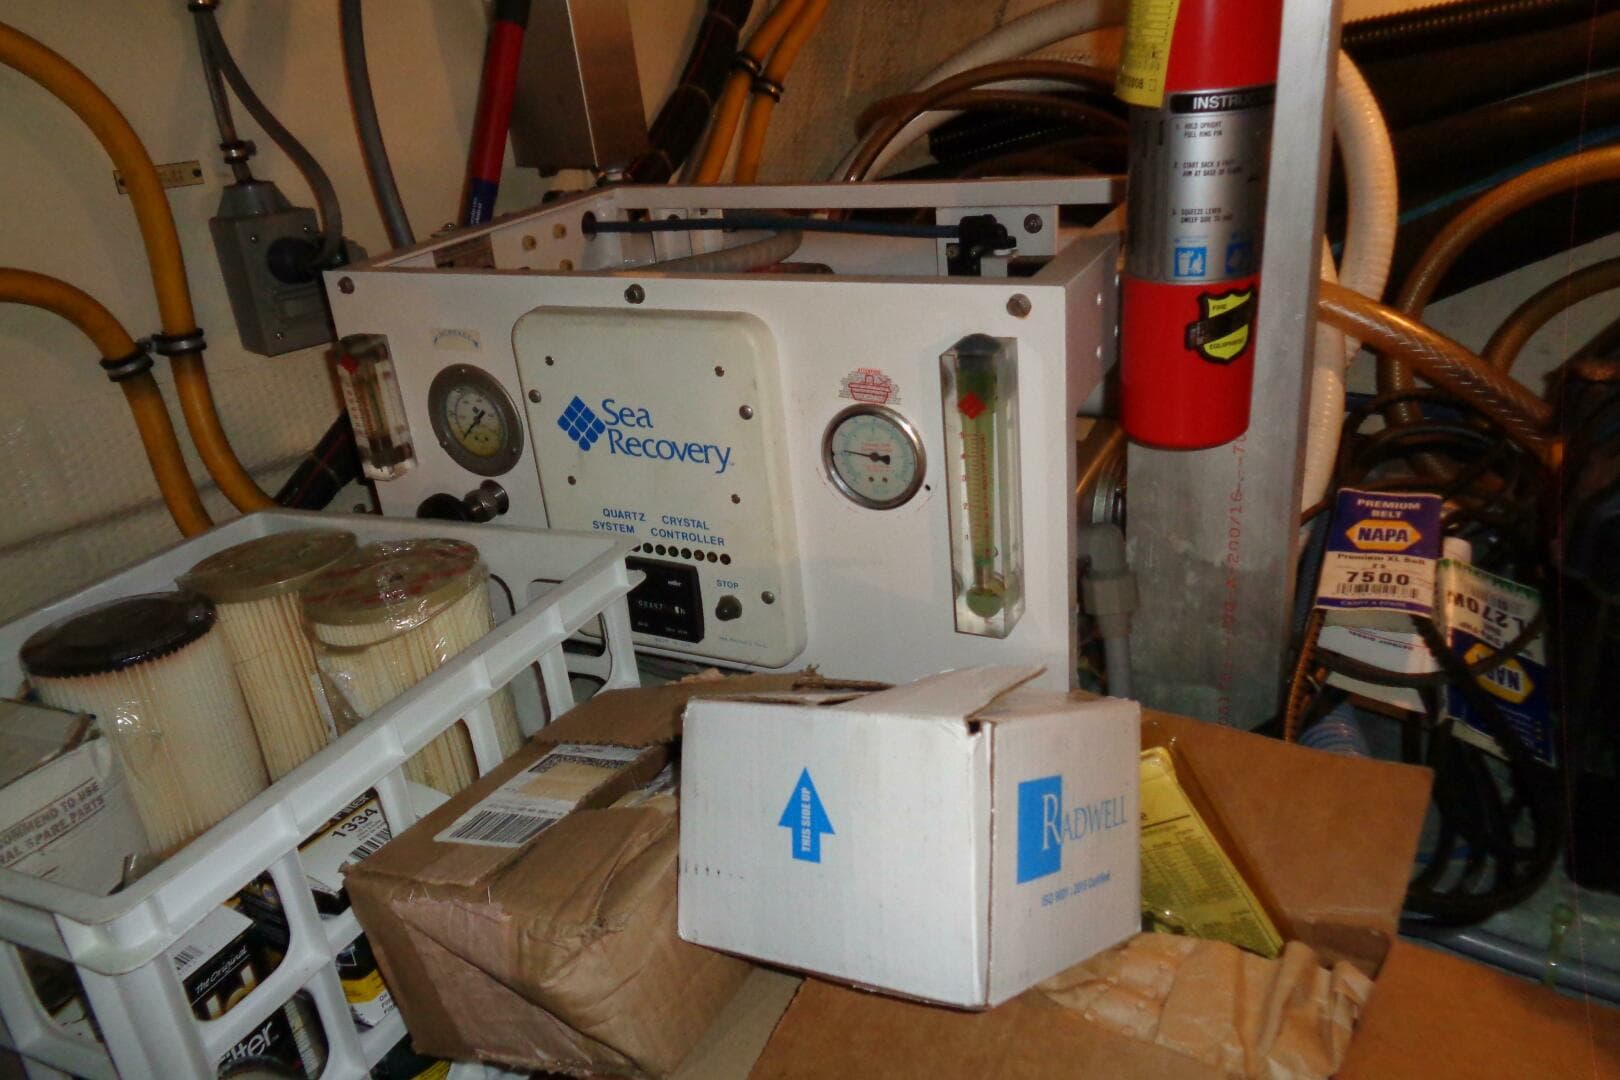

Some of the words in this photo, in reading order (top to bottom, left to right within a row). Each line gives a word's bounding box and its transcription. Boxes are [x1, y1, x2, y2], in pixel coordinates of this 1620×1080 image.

[601, 397, 654, 429] Sea
[606, 427, 732, 475] Recovery
[1356, 499, 1421, 510] PREMIUM
[1371, 509, 1403, 519] BELT
[602, 508, 647, 522] QUARTZ
[661, 515, 710, 531] CRYSTAL
[592, 520, 635, 534] SYSTEM
[650, 527, 725, 546] CONTROLLER
[1357, 526, 1409, 542] NAPA
[716, 579, 739, 589] STOP
[1346, 571, 1410, 585] 7500
[801, 787, 811, 801] UP
[332, 807, 378, 838] 1334
[801, 803, 811, 828] SIDE
[1040, 793, 1128, 851] RADWELL
[801, 829, 811, 852] THIS
